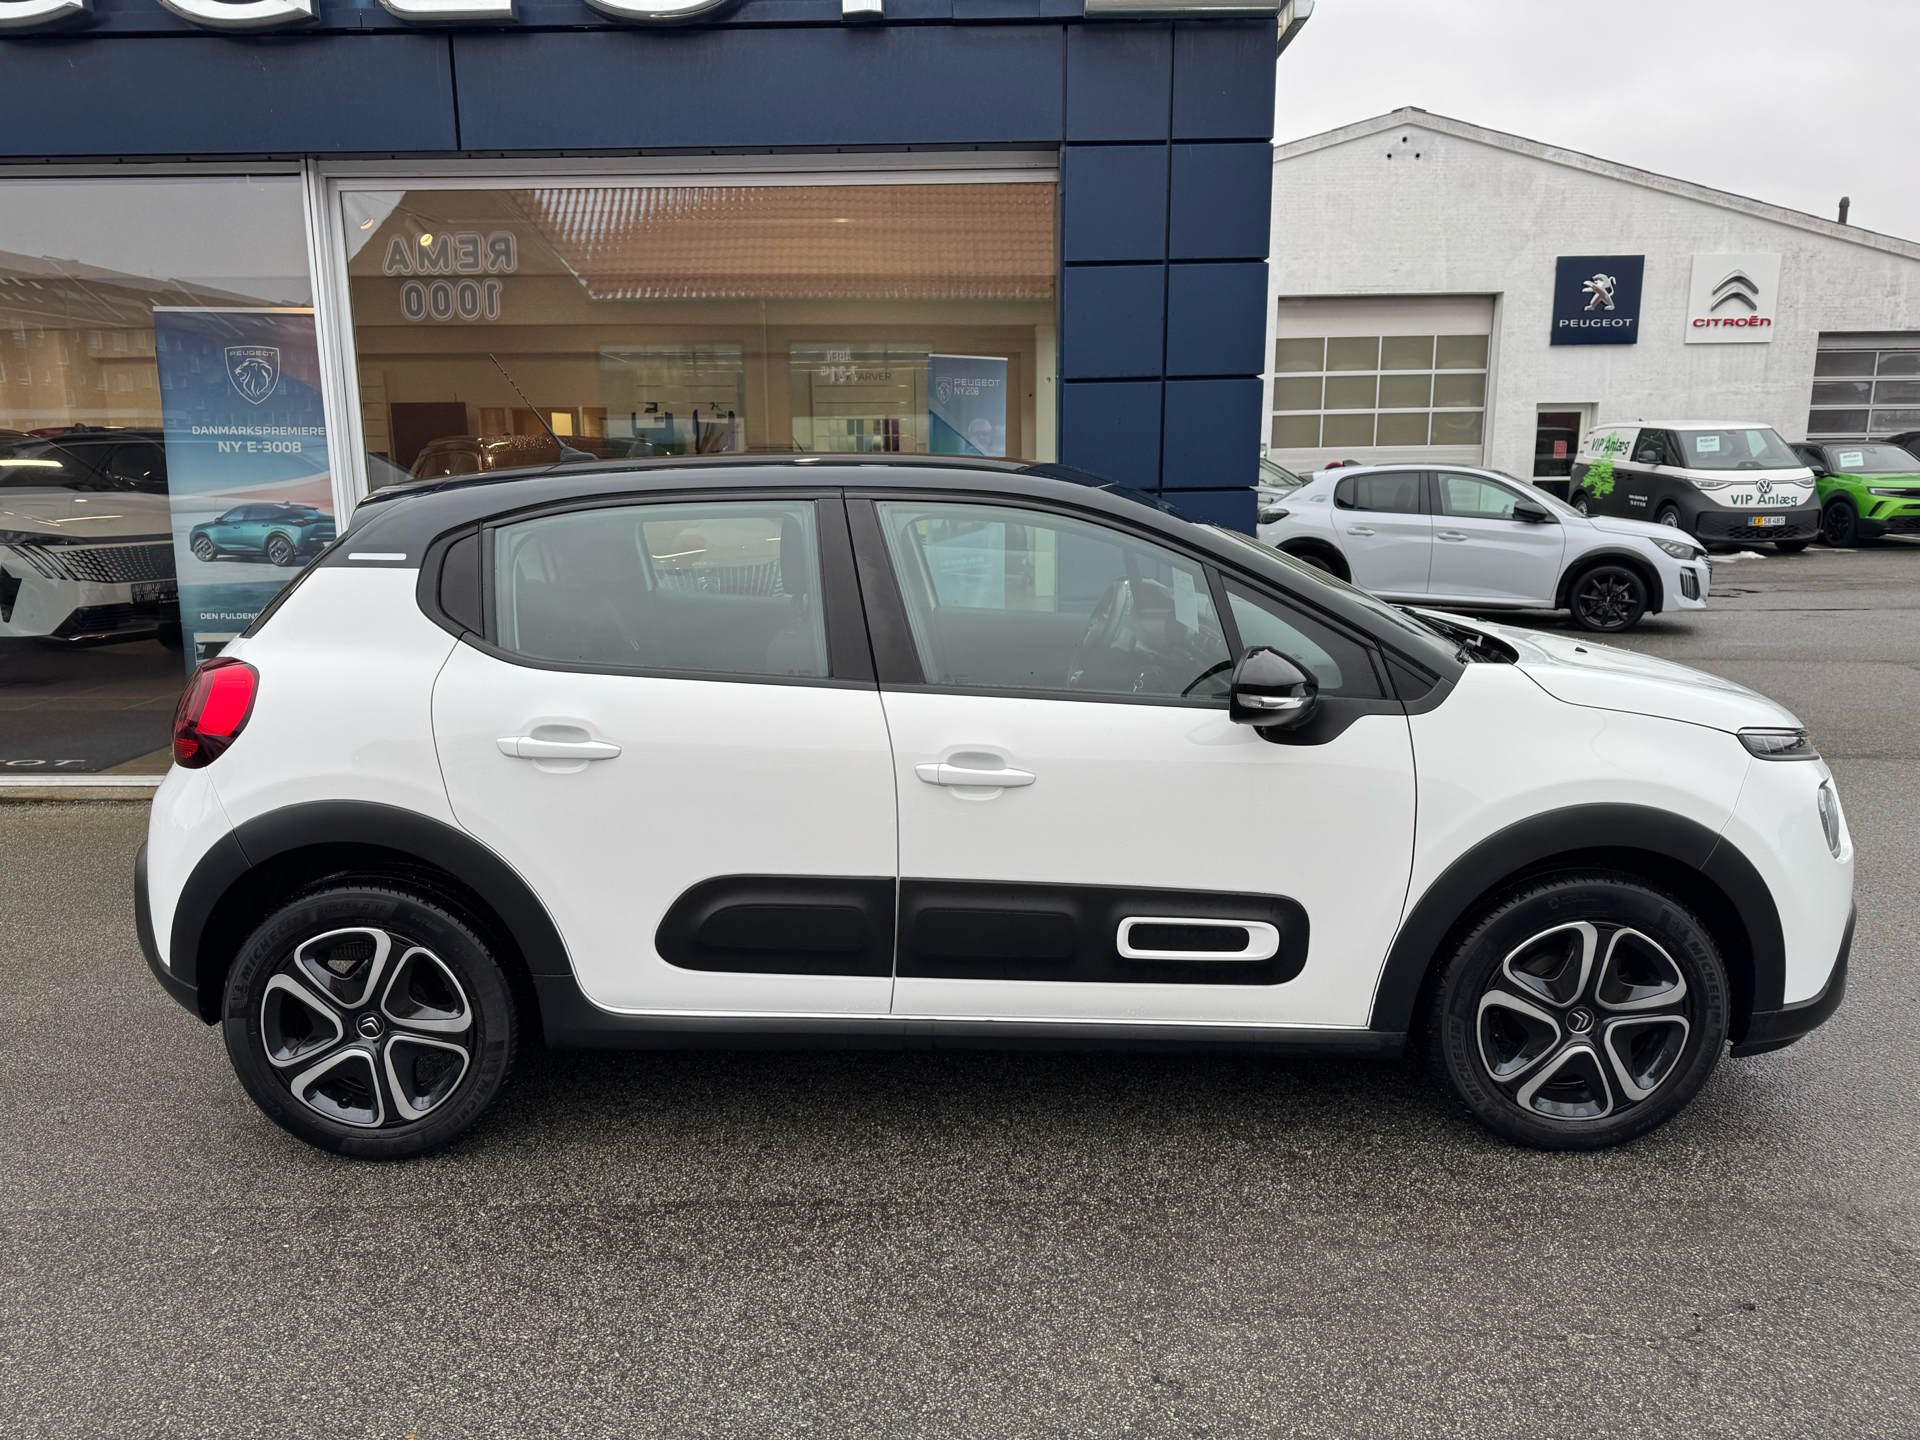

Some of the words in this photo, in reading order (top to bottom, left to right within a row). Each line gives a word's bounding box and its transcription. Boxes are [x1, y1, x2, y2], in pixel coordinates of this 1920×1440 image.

[1559, 318, 1634, 328] PEUGEOT
[953, 378, 1001, 387] PEUGEOT
[954, 386, 965, 396] NY
[966, 387, 979, 396] 208
[192, 426, 326, 436] DANMARKSPREMIERE
[218, 442, 242, 453] NY
[247, 442, 302, 453] E-3008
[1591, 438, 1604, 451] VIP
[1730, 494, 1753, 505] VIP
[1757, 493, 1798, 506] Anlæg
[0, 759, 87, 767] OT
[374, 904, 386, 913] 16
[1688, 940, 1721, 1024] MICHELIN
[1451, 1020, 1486, 1103] MICHELIN
